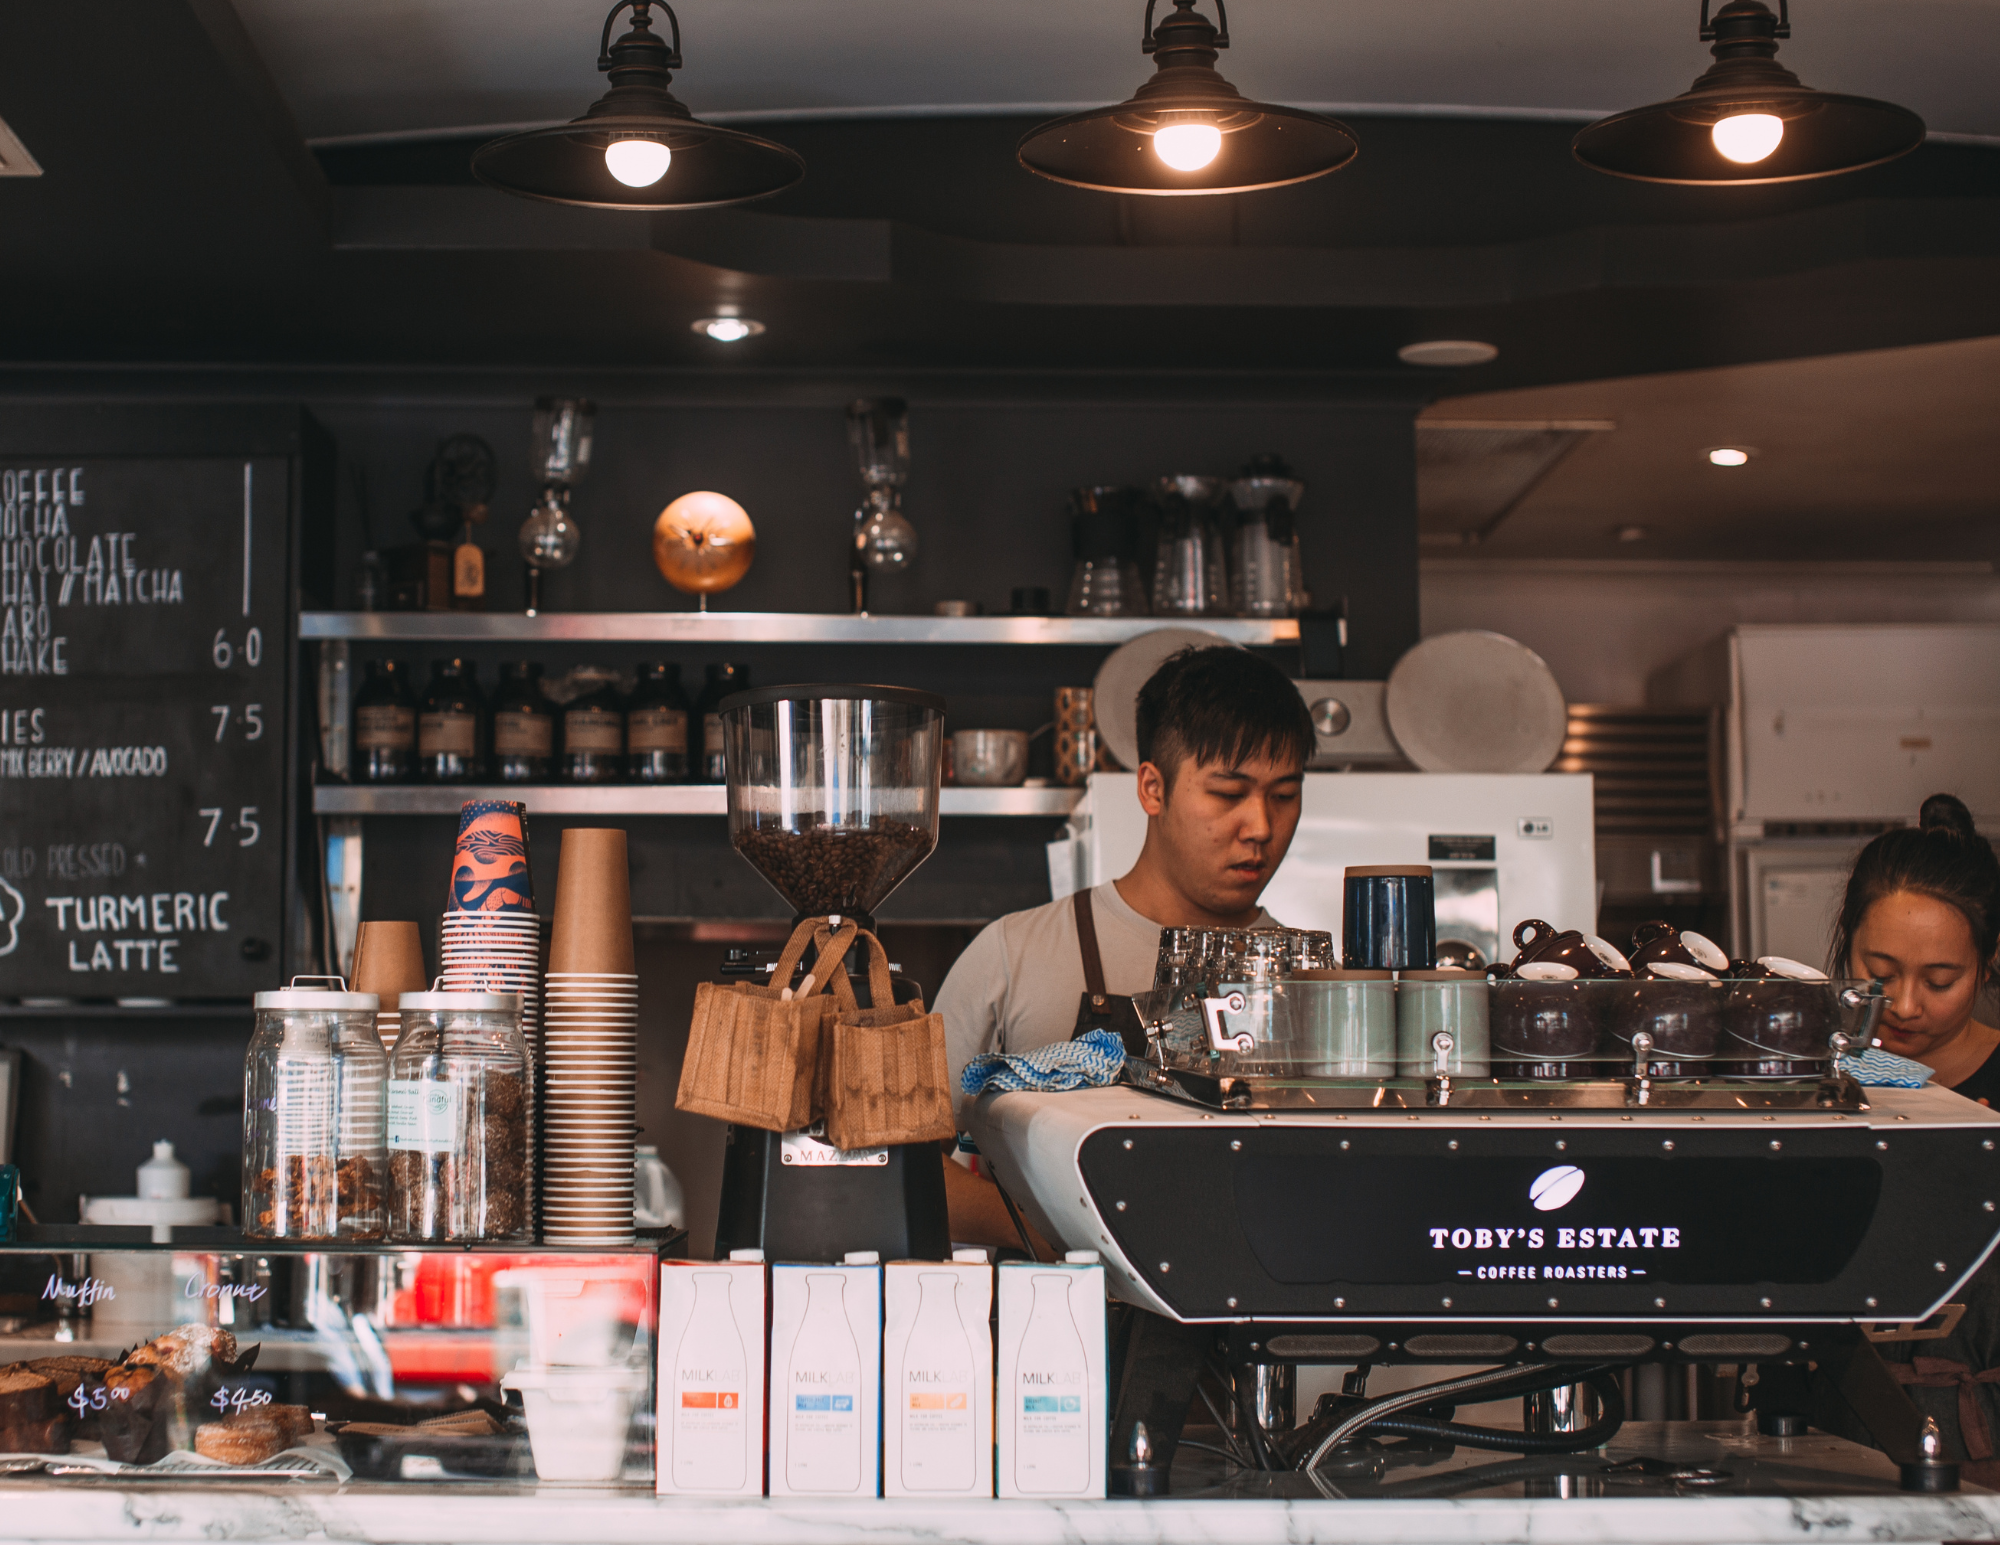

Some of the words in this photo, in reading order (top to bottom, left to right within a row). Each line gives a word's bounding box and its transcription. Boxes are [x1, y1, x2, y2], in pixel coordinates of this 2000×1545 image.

[0, 502, 70, 540] OCHA
[45, 891, 230, 934] TURMERIC
[68, 939, 180, 973] LATTE
[1429, 1228, 1545, 1249] TOBY'S
[1557, 1227, 1680, 1249] ESTATE
[1477, 1266, 1537, 1279] COFFEE
[1543, 1266, 1628, 1279] ROASTERS
[41, 1273, 117, 1307] Muffin
